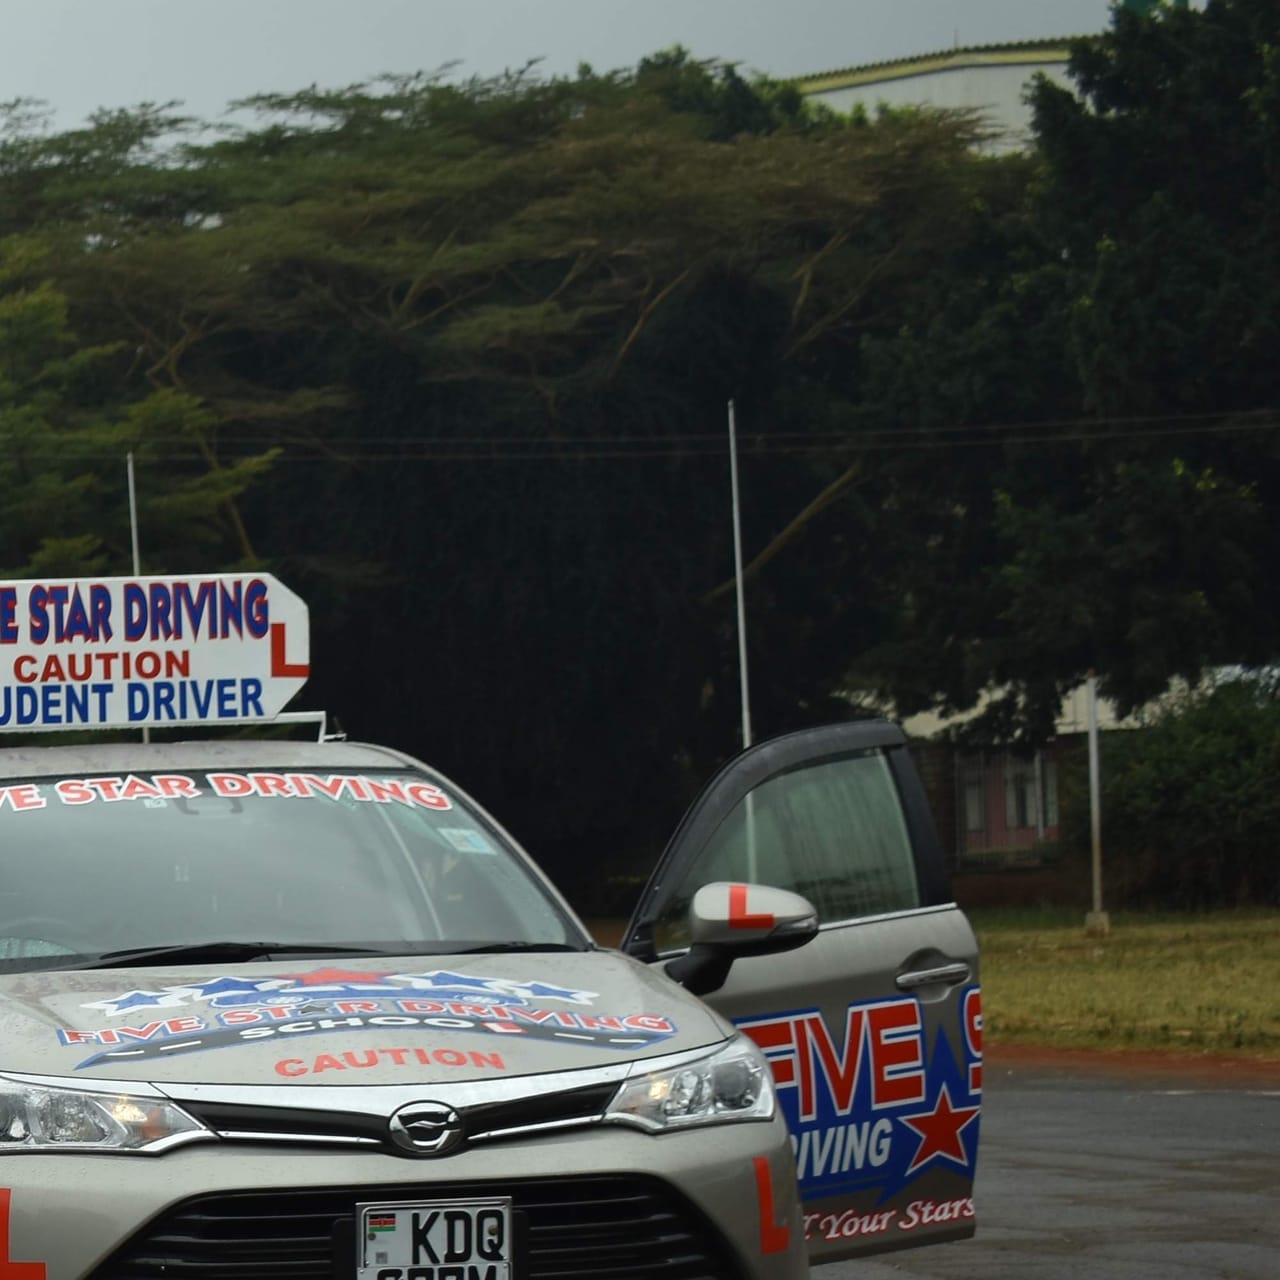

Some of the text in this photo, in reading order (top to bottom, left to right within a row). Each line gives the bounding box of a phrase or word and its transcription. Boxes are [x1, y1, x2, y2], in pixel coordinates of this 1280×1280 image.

[29, 583, 113, 645] STAR
[124, 579, 269, 643] DRIVING
[13, 650, 190, 683] CAUTION
[270, 622, 310, 678] L
[127, 677, 264, 722] DRIVER
[56, 774, 202, 805] STAR
[206, 772, 452, 811] DRIVING
[729, 885, 774, 929] L
[60, 1015, 206, 1046] FIVE
[397, 1000, 678, 1034] DRIVING
[240, 1015, 526, 1040] SCHOOL
[274, 1047, 506, 1077] CAUTION
[754, 1157, 789, 1254] L
[819, 1207, 896, 1240] Your
[899, 1197, 975, 1230] Stars
[411, 1208, 506, 1265] KDQ
